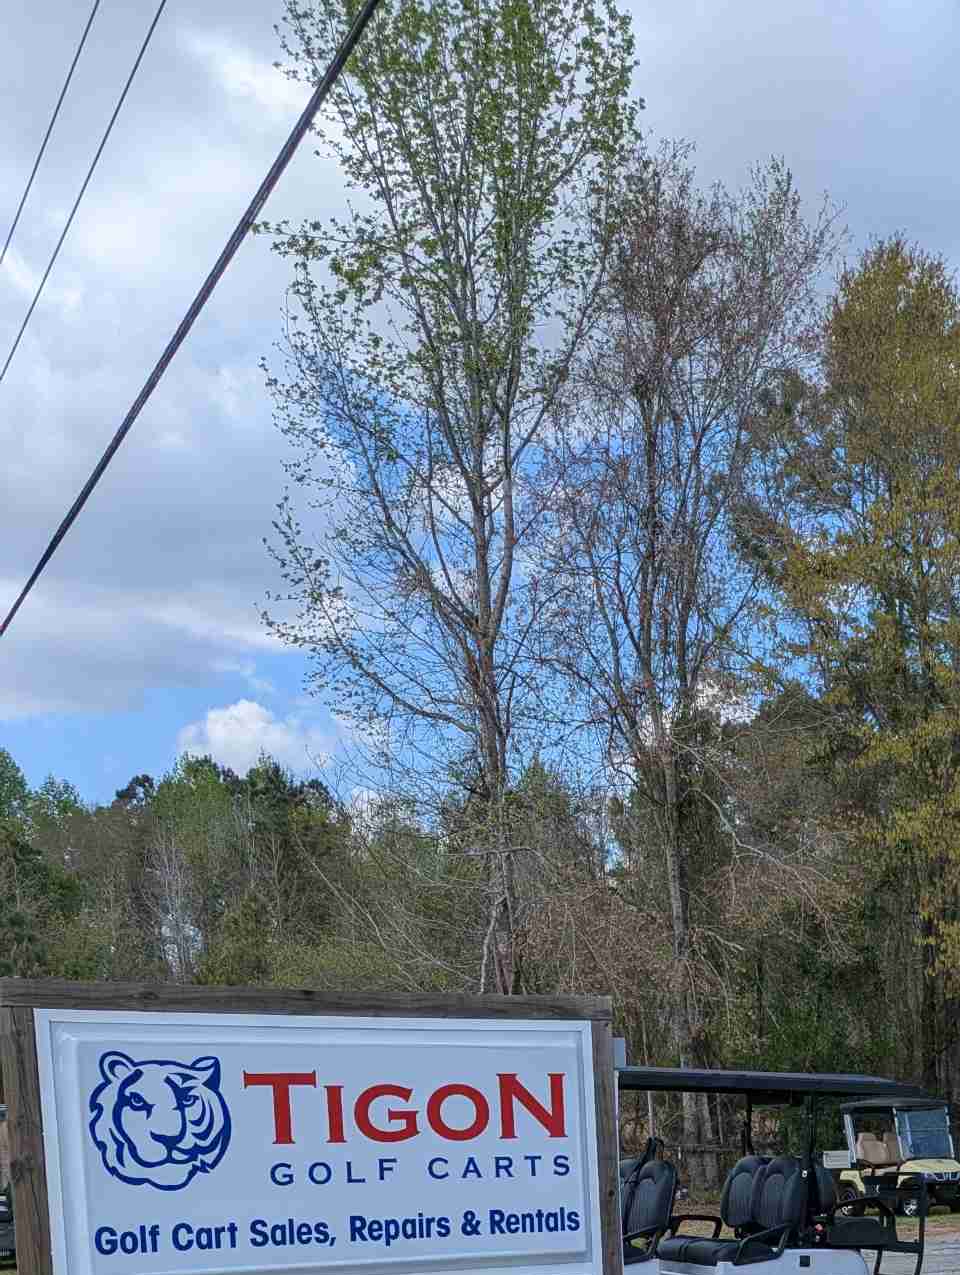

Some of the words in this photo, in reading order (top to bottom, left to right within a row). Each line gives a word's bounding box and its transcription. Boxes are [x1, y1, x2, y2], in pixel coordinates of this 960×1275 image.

[243, 1070, 568, 1144] TIGON
[270, 1158, 397, 1186] GOLF
[428, 1155, 570, 1180] CARTS
[95, 1225, 160, 1255] Golf
[172, 1223, 238, 1251] Cart
[250, 1219, 336, 1247] Sales,
[350, 1213, 450, 1246] Repairs
[461, 1211, 481, 1236] &
[489, 1207, 580, 1234] Rentals
